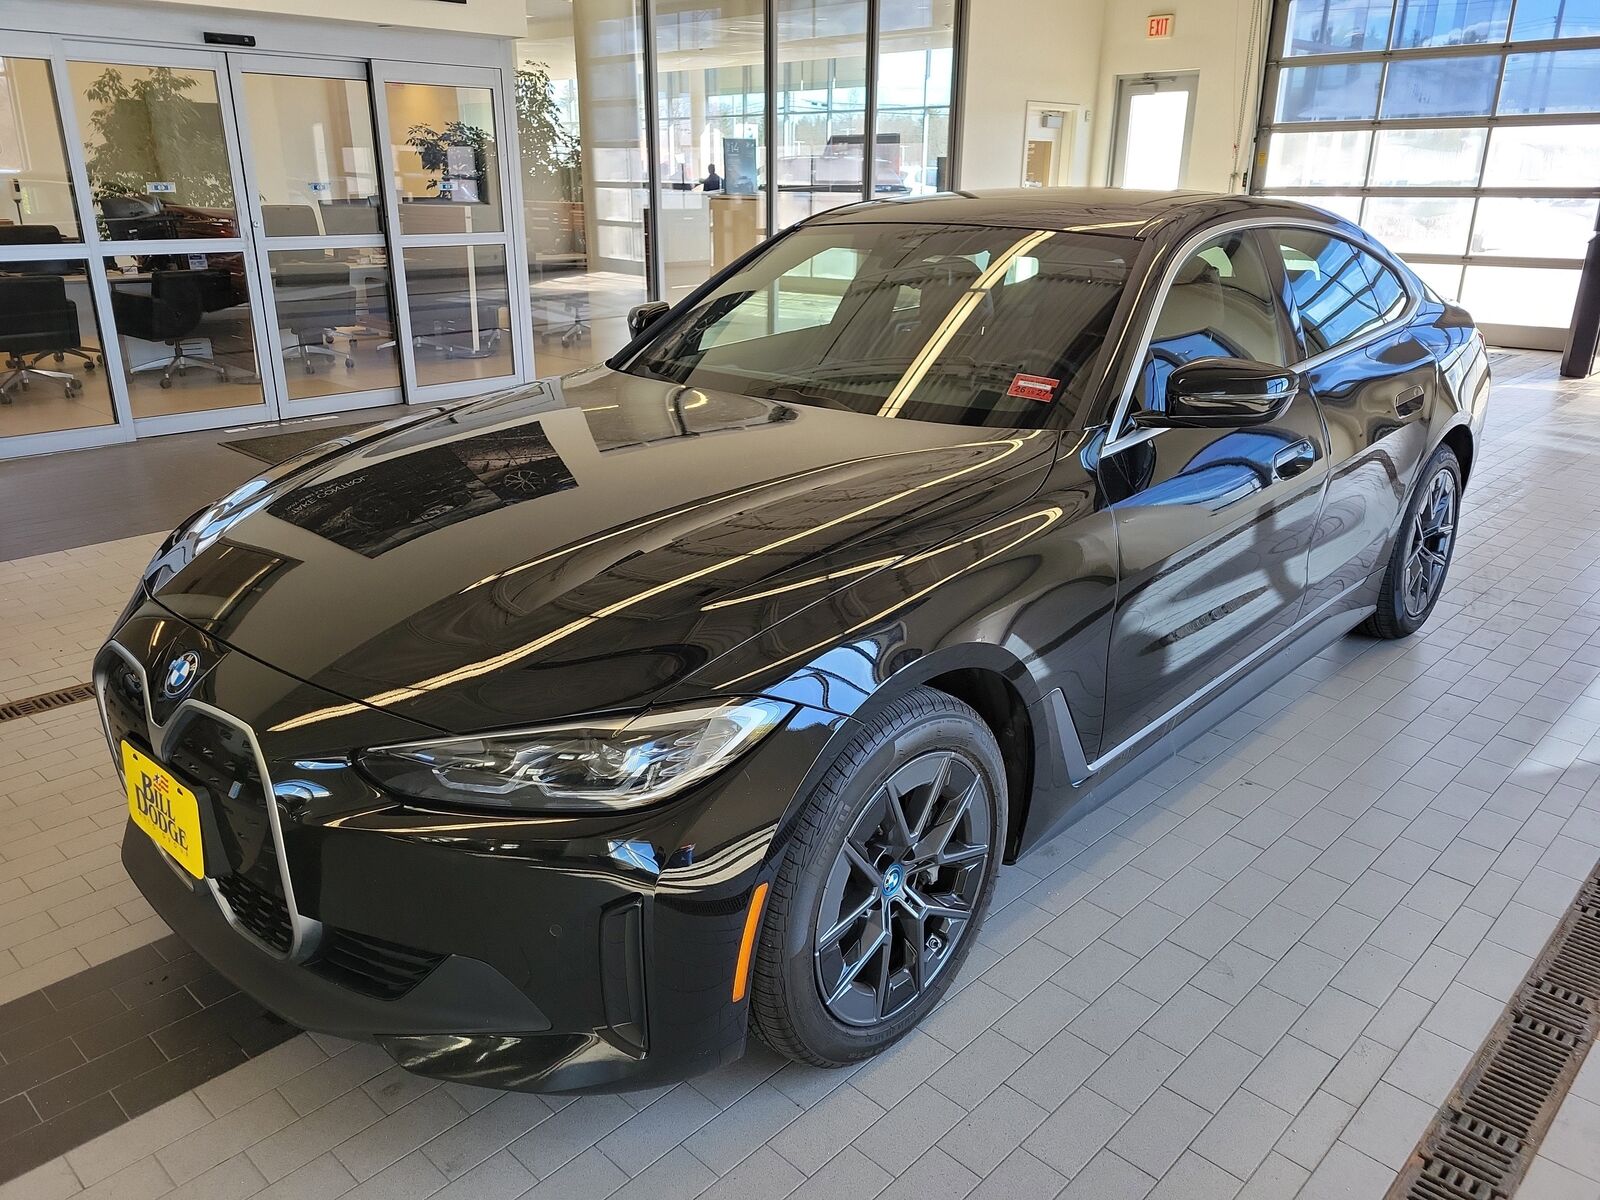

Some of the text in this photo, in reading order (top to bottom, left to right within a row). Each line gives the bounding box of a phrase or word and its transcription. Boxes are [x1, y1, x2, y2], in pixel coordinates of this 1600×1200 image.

[1149, 17, 1170, 36] EXIT
[1014, 385, 1026, 393] 26
[140, 770, 176, 822] BILL
[134, 783, 189, 851] DODGE
